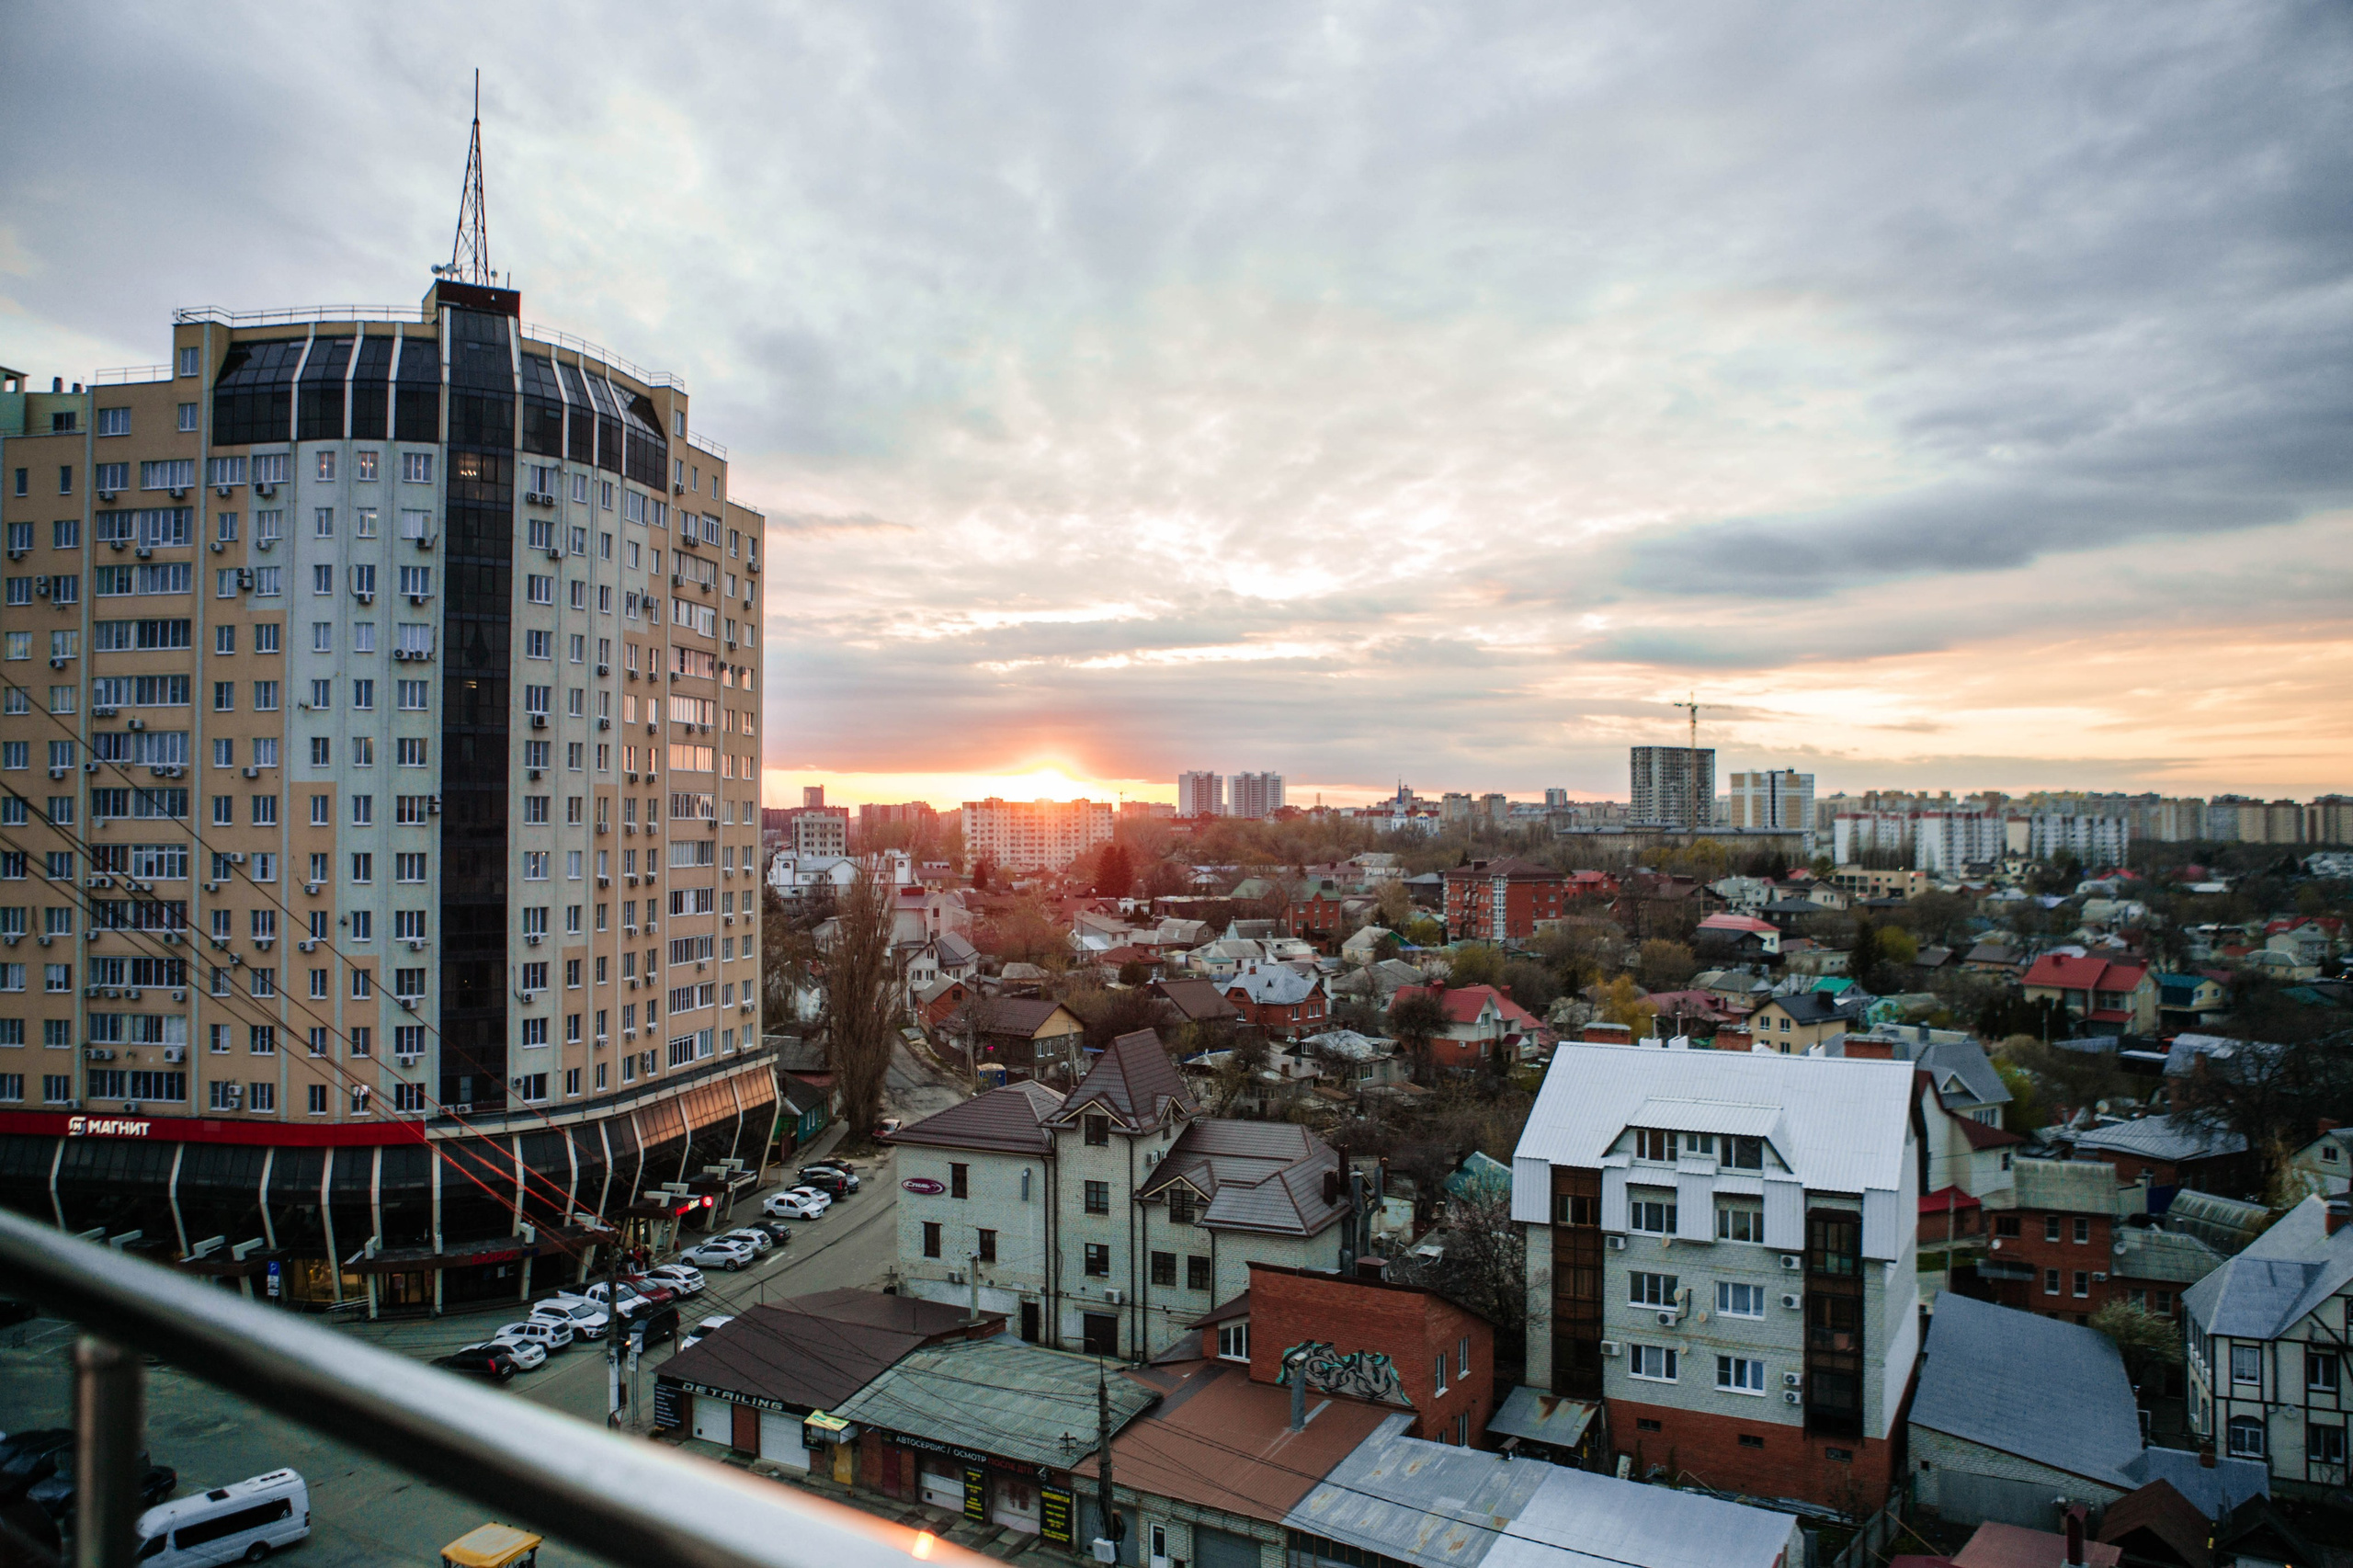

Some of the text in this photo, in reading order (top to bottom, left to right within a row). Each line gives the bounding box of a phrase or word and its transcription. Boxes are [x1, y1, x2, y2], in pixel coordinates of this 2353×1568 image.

[87, 1119, 151, 1136] МАГНИТ
[682, 1381, 784, 1411] DETAILING
[953, 1449, 987, 1463] ОСМОТР
[988, 1457, 1016, 1471] ПОСЛЕ
[1016, 1464, 1034, 1475] ДТП
